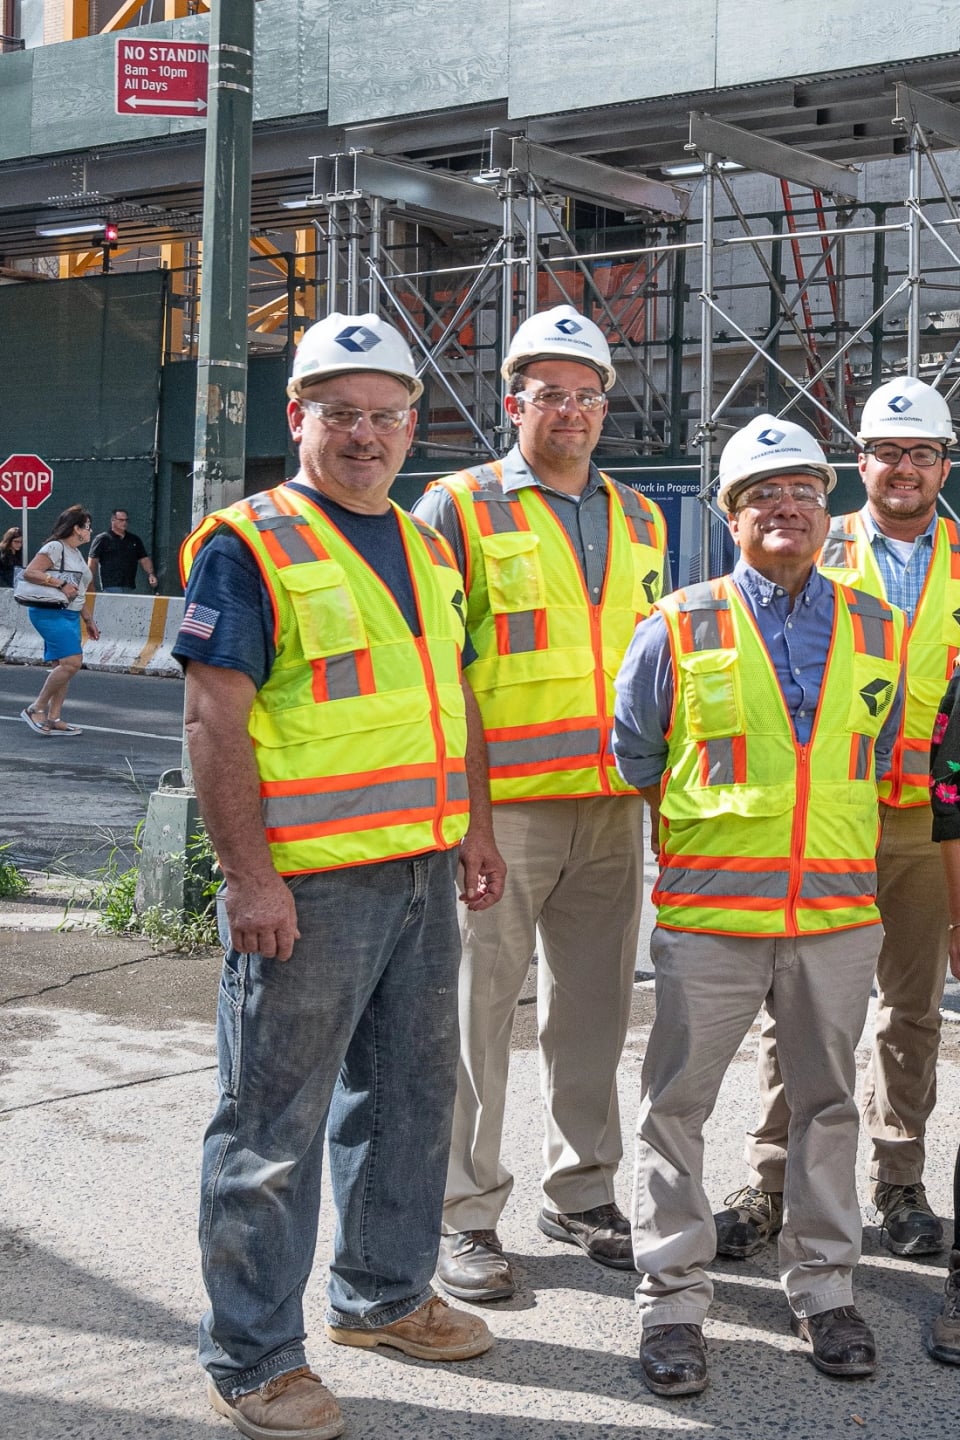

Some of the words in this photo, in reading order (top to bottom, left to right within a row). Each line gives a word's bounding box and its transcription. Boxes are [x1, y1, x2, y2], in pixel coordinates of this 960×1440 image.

[124, 46, 145, 60] NO
[149, 47, 209, 63] STANDIN
[124, 64, 149, 76] 8am
[159, 65, 188, 79] 10pm
[124, 78, 139, 89] All
[141, 79, 168, 93] Days
[1, 471, 50, 492] STOP
[631, 483, 656, 492] Work
[656, 482, 665, 492] in
[667, 482, 700, 494] Progres
